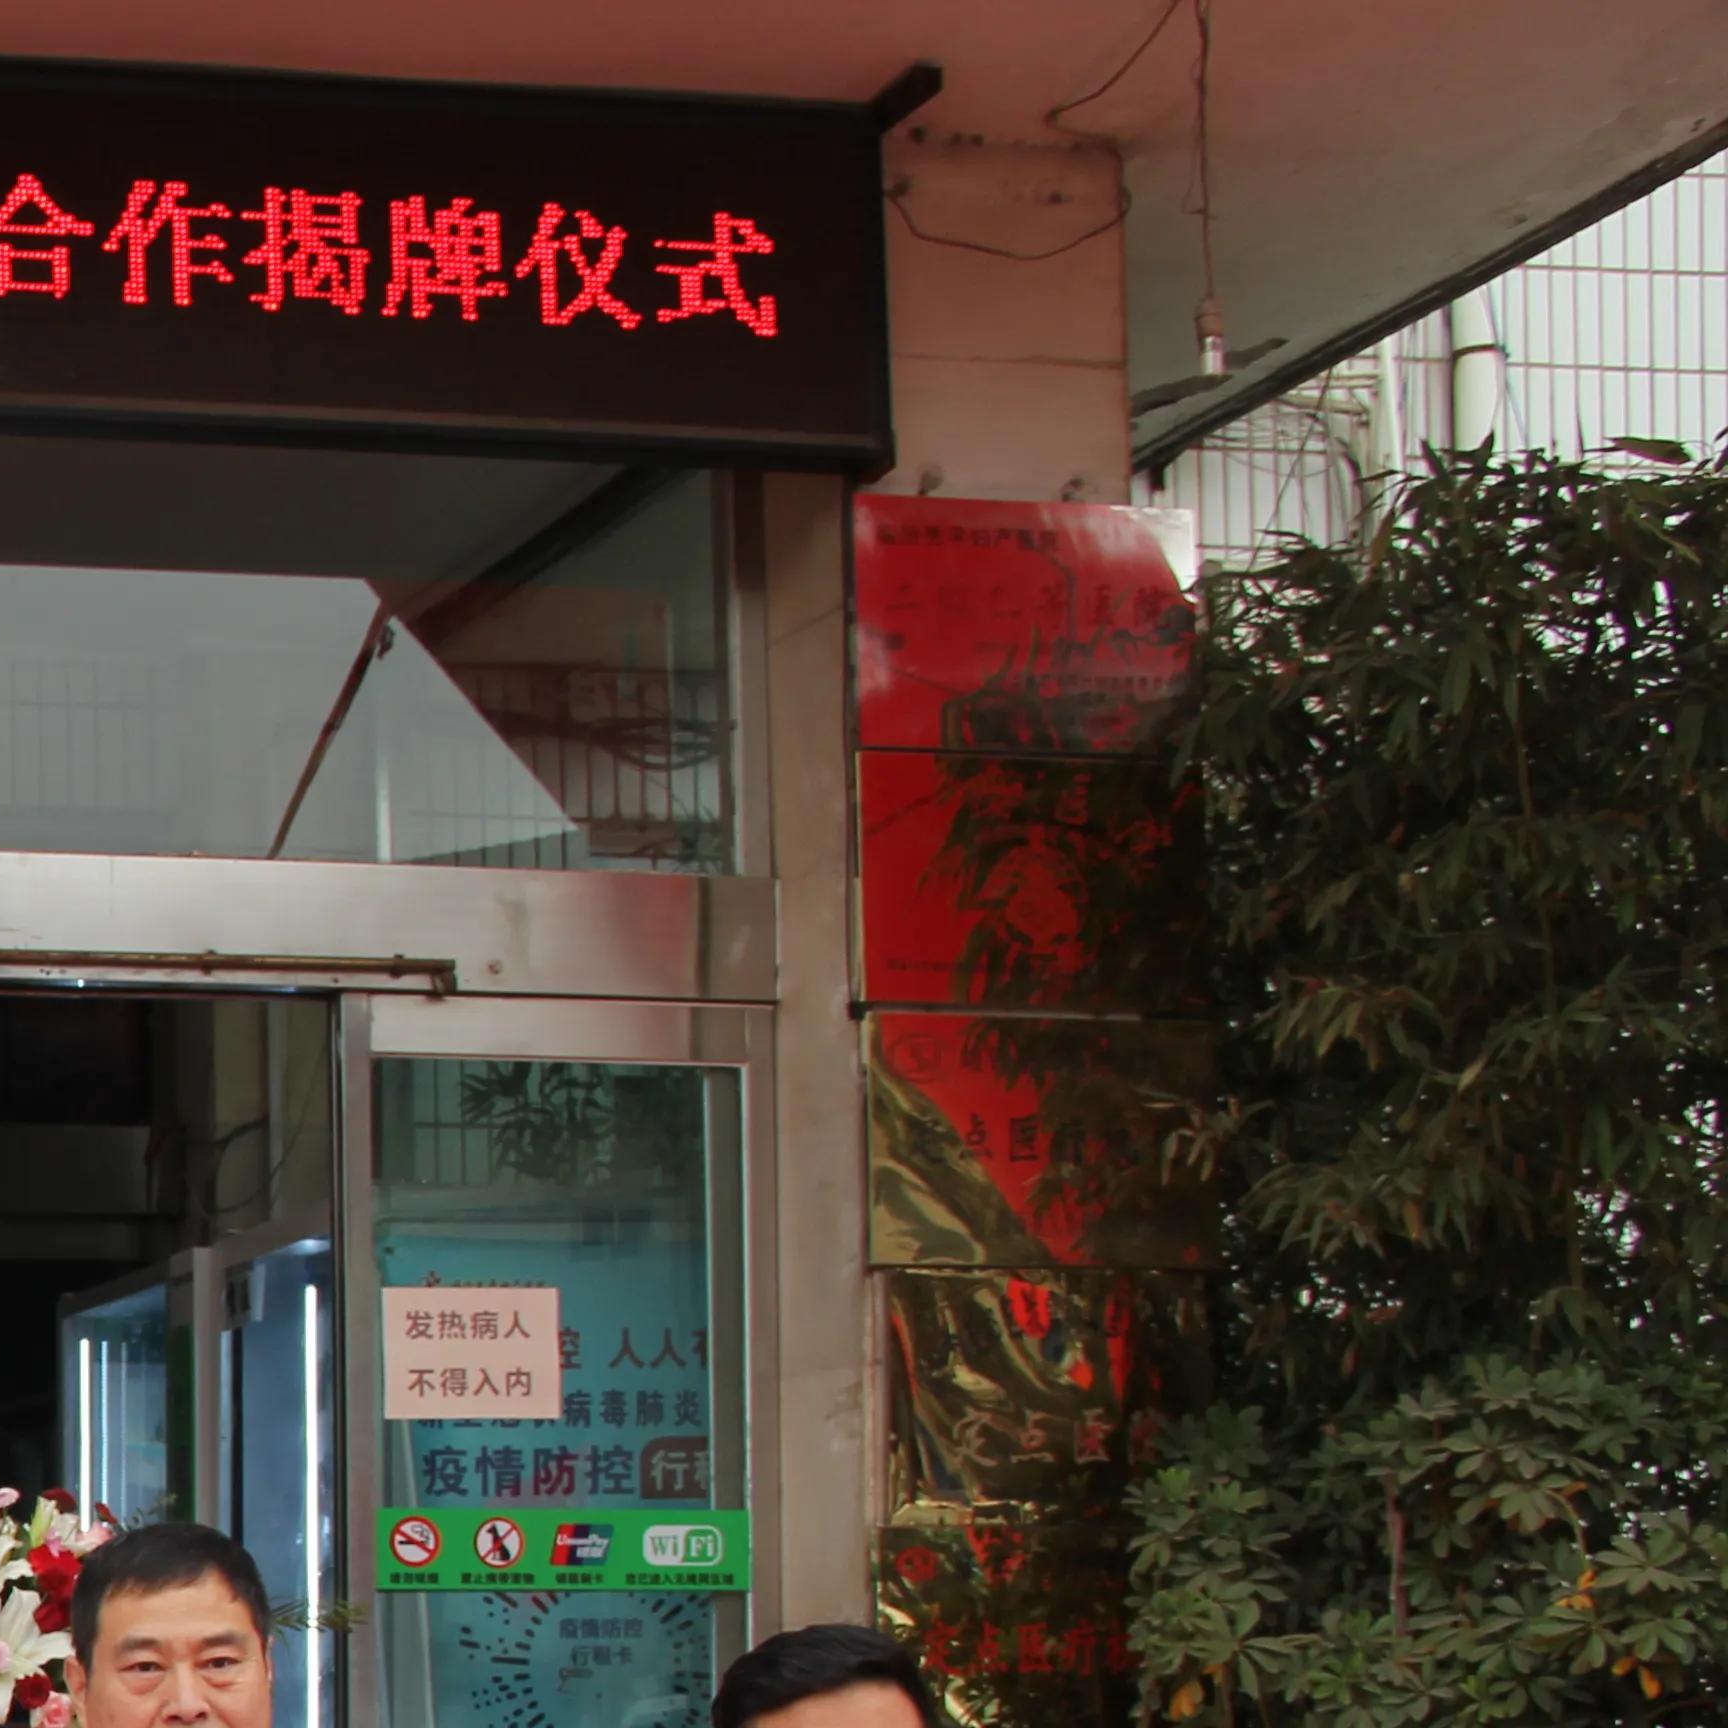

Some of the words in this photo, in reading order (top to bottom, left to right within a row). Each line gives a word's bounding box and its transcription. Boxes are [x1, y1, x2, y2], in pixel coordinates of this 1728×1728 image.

[405, 1310, 531, 1341] 发热病人
[408, 1367, 532, 1398] 不得入内
[423, 1445, 636, 1498] 疫情防控
[558, 1616, 644, 1640] 疫情防控
